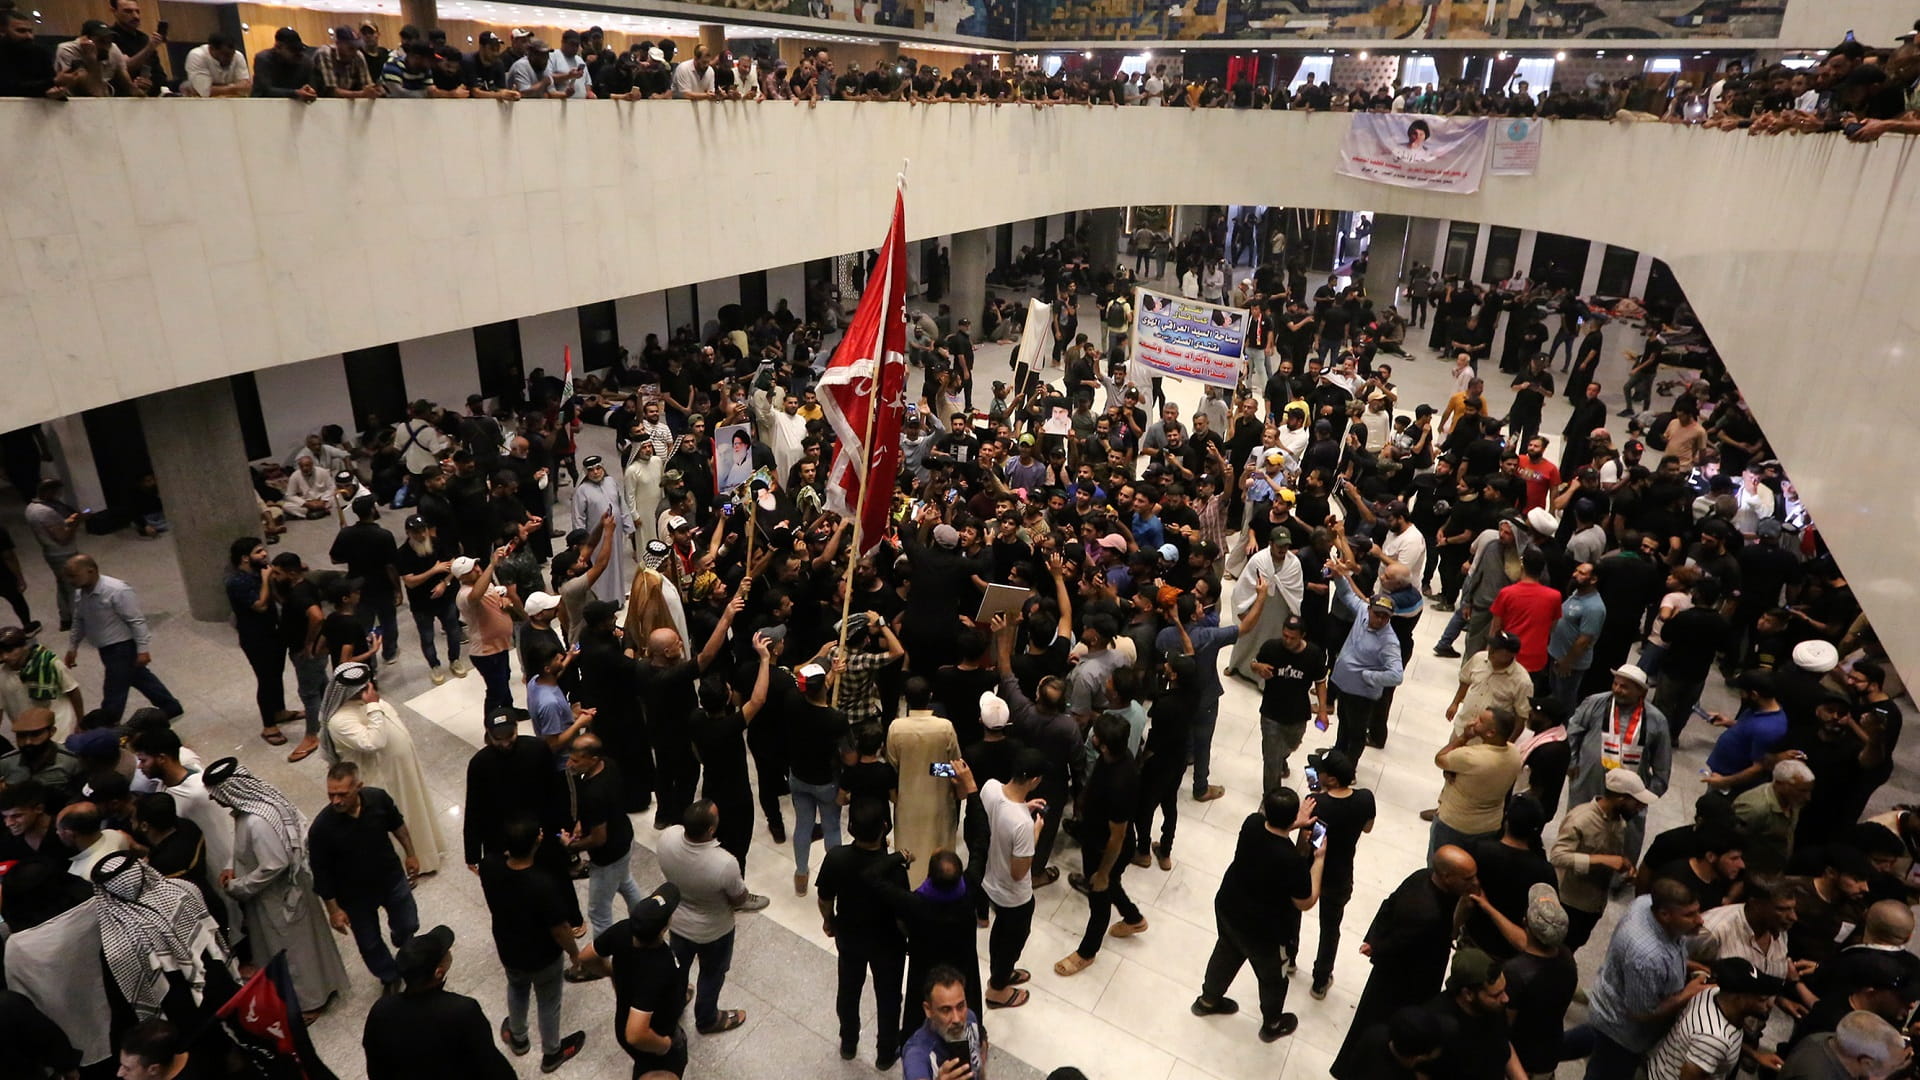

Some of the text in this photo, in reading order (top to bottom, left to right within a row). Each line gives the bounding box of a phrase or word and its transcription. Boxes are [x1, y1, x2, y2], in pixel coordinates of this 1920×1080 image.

[1172, 311, 1208, 325] كما قال
[1161, 320, 1190, 333] العراقي
[1191, 326, 1213, 338] السيد
[1214, 330, 1239, 343] سماحة
[1172, 337, 1220, 352] مقتدى الصدر
[1174, 363, 1204, 375] الوطن
